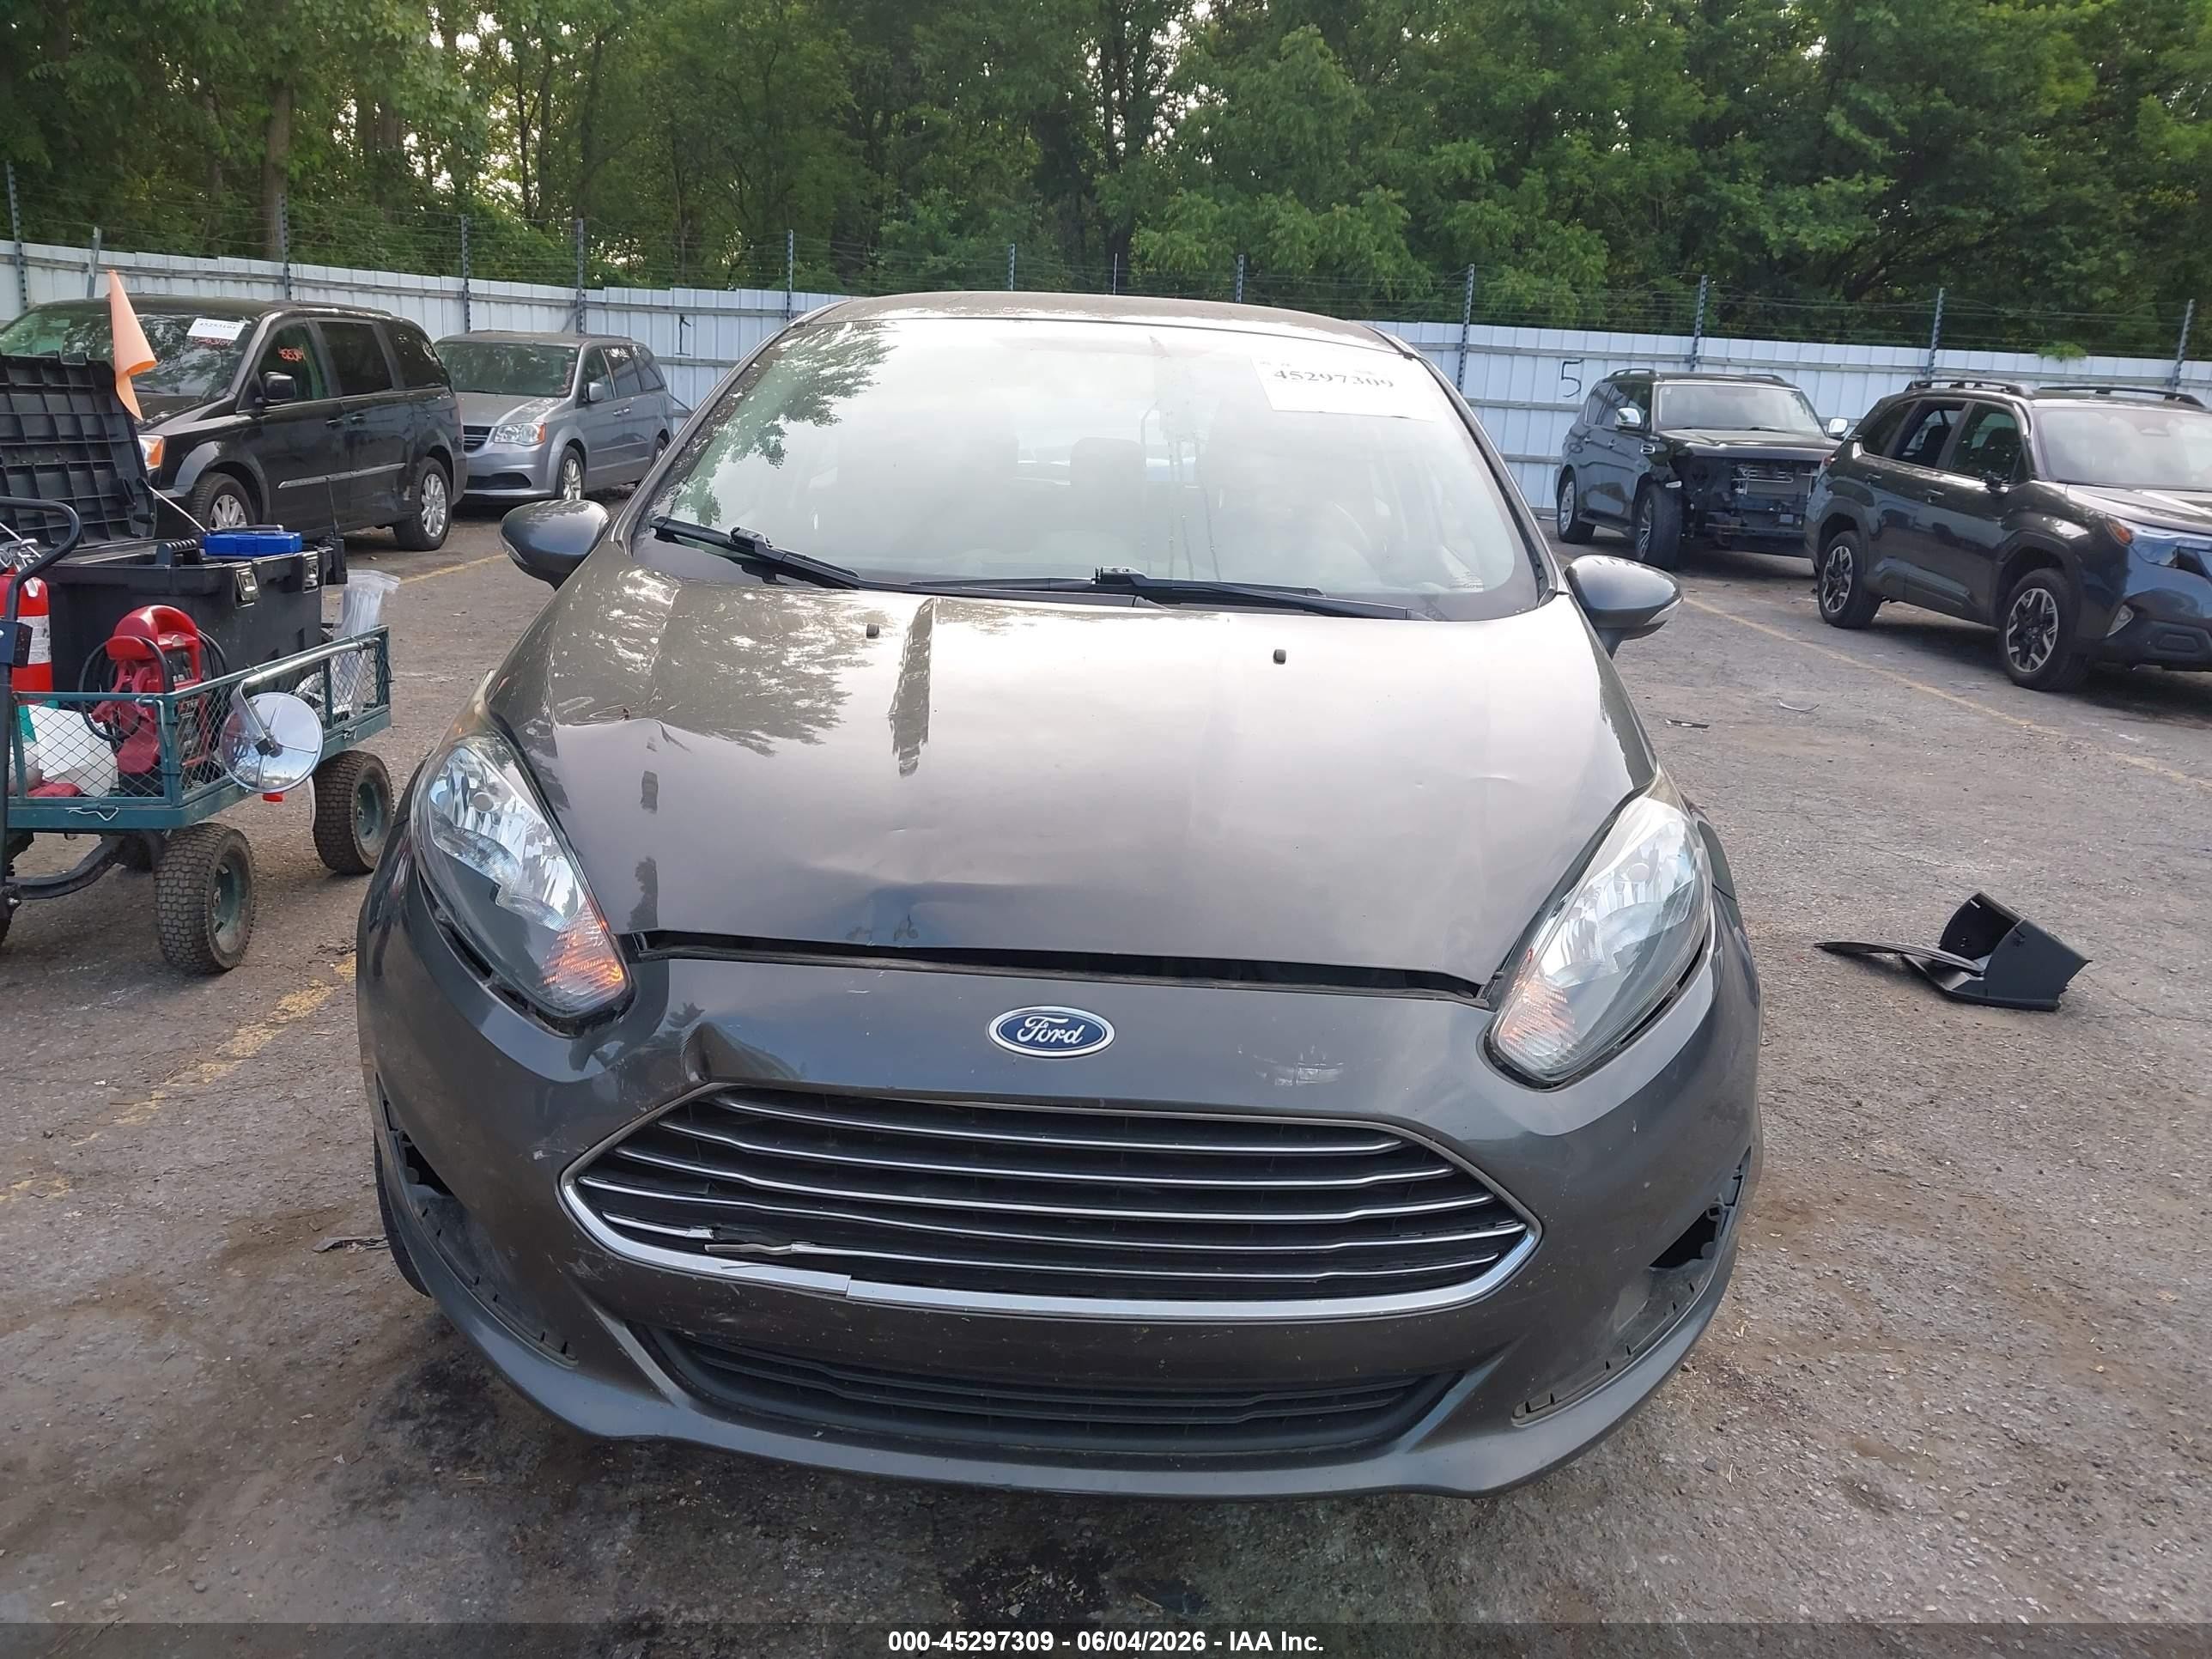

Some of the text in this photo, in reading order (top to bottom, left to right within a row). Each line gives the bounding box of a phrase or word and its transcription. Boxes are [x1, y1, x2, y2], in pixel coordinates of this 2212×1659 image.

[1274, 370, 1395, 387] 45297309
[1561, 357, 1584, 398] 5
[1017, 1016, 1085, 1044] Ford
